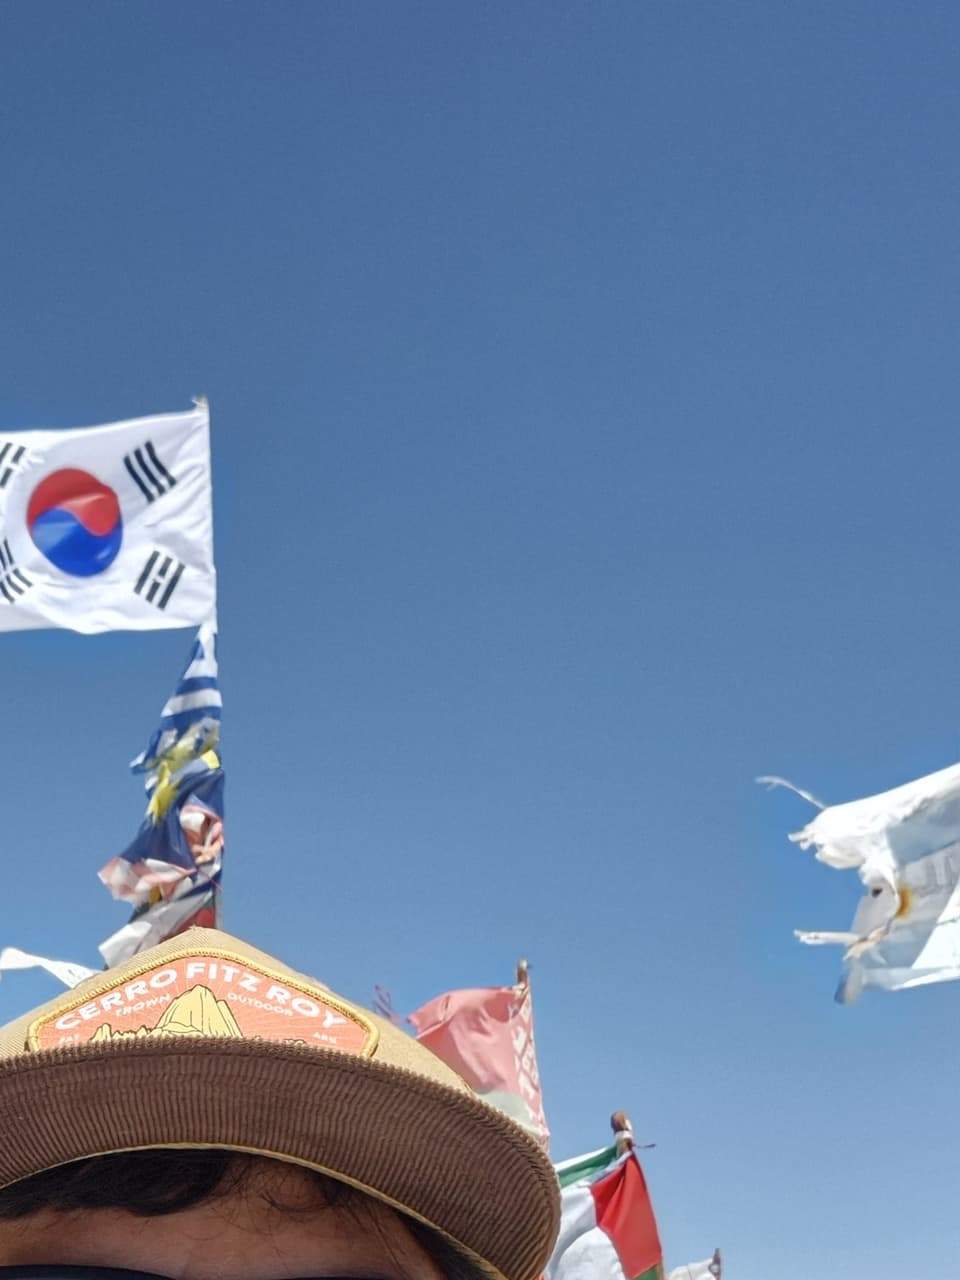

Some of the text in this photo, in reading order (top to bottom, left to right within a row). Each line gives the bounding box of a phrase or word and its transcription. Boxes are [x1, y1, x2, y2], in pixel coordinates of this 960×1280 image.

[55, 962, 347, 1031] CERRO FITZ ROY
[227, 992, 294, 1017] OUTDOOR
